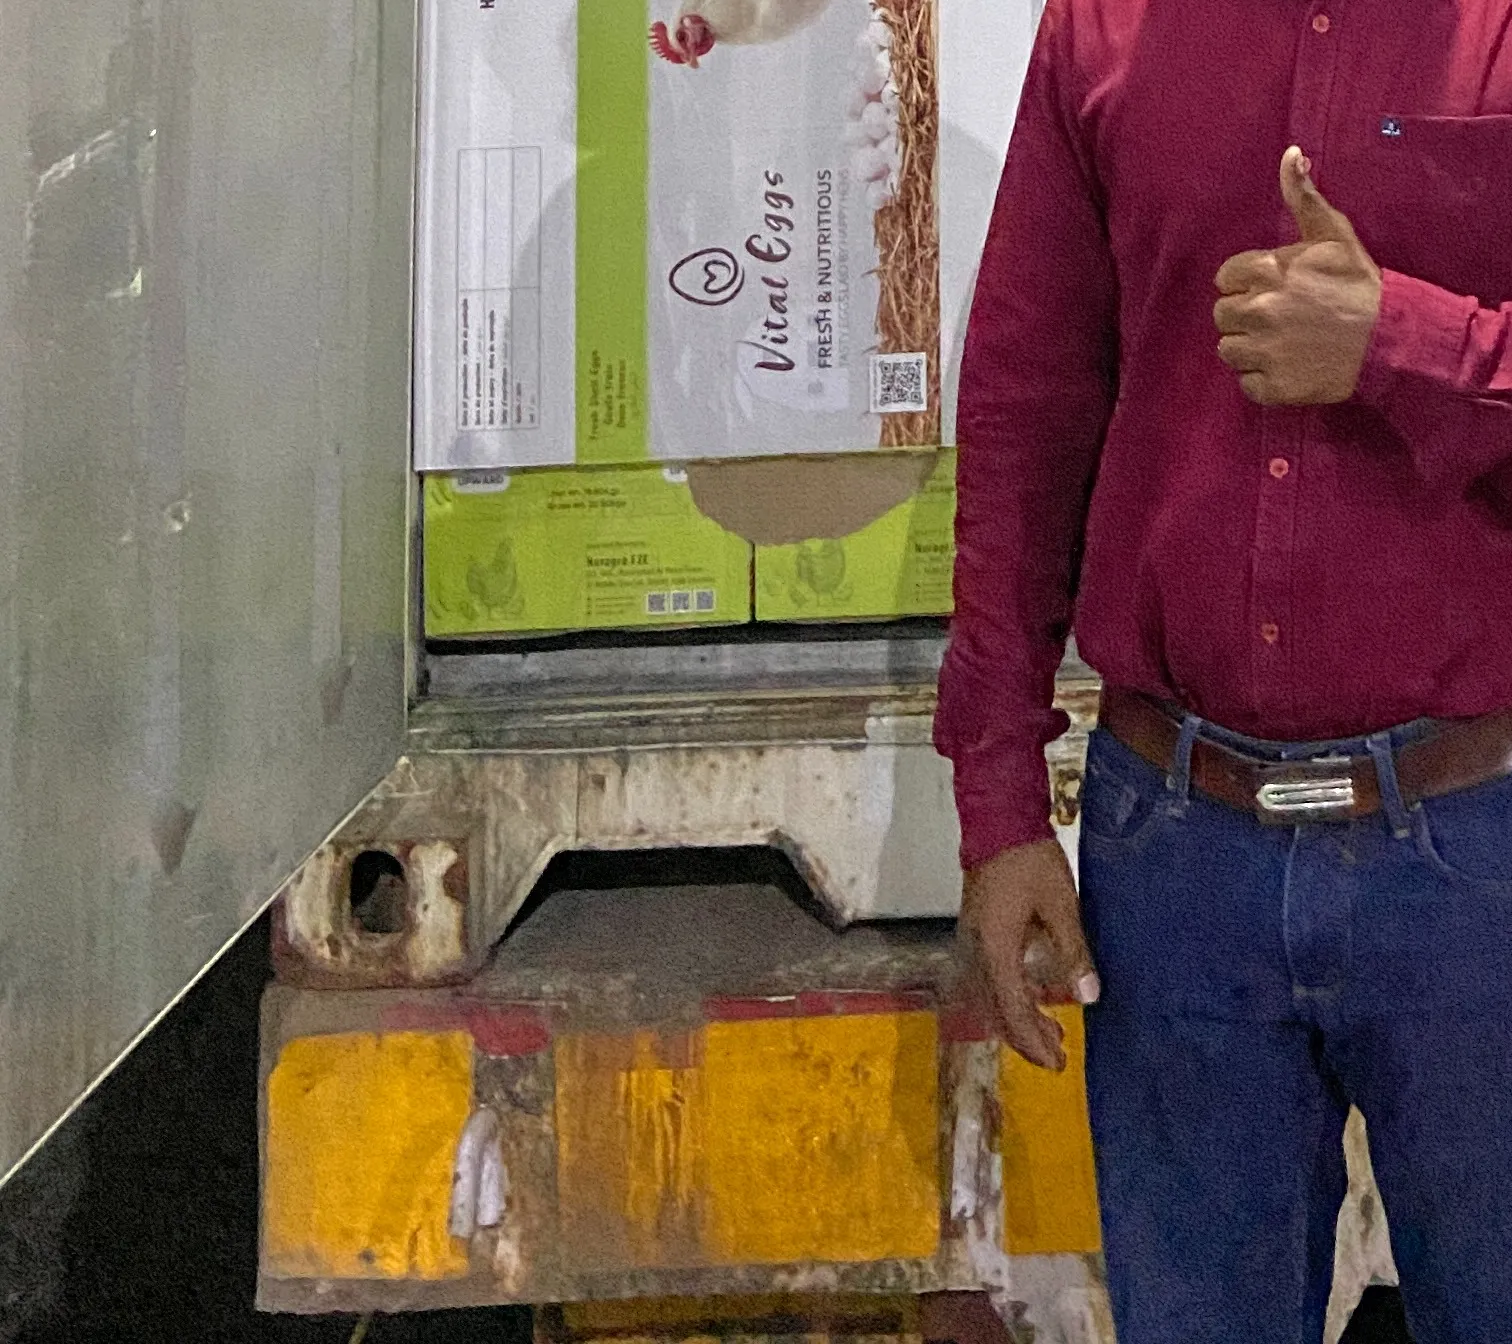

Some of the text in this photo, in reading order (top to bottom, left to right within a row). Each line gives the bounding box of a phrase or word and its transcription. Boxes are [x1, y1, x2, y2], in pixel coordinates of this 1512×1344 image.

[737, 170, 795, 371] Vital Eggs
[817, 170, 832, 368] FRESH & NUTRITIOUS
